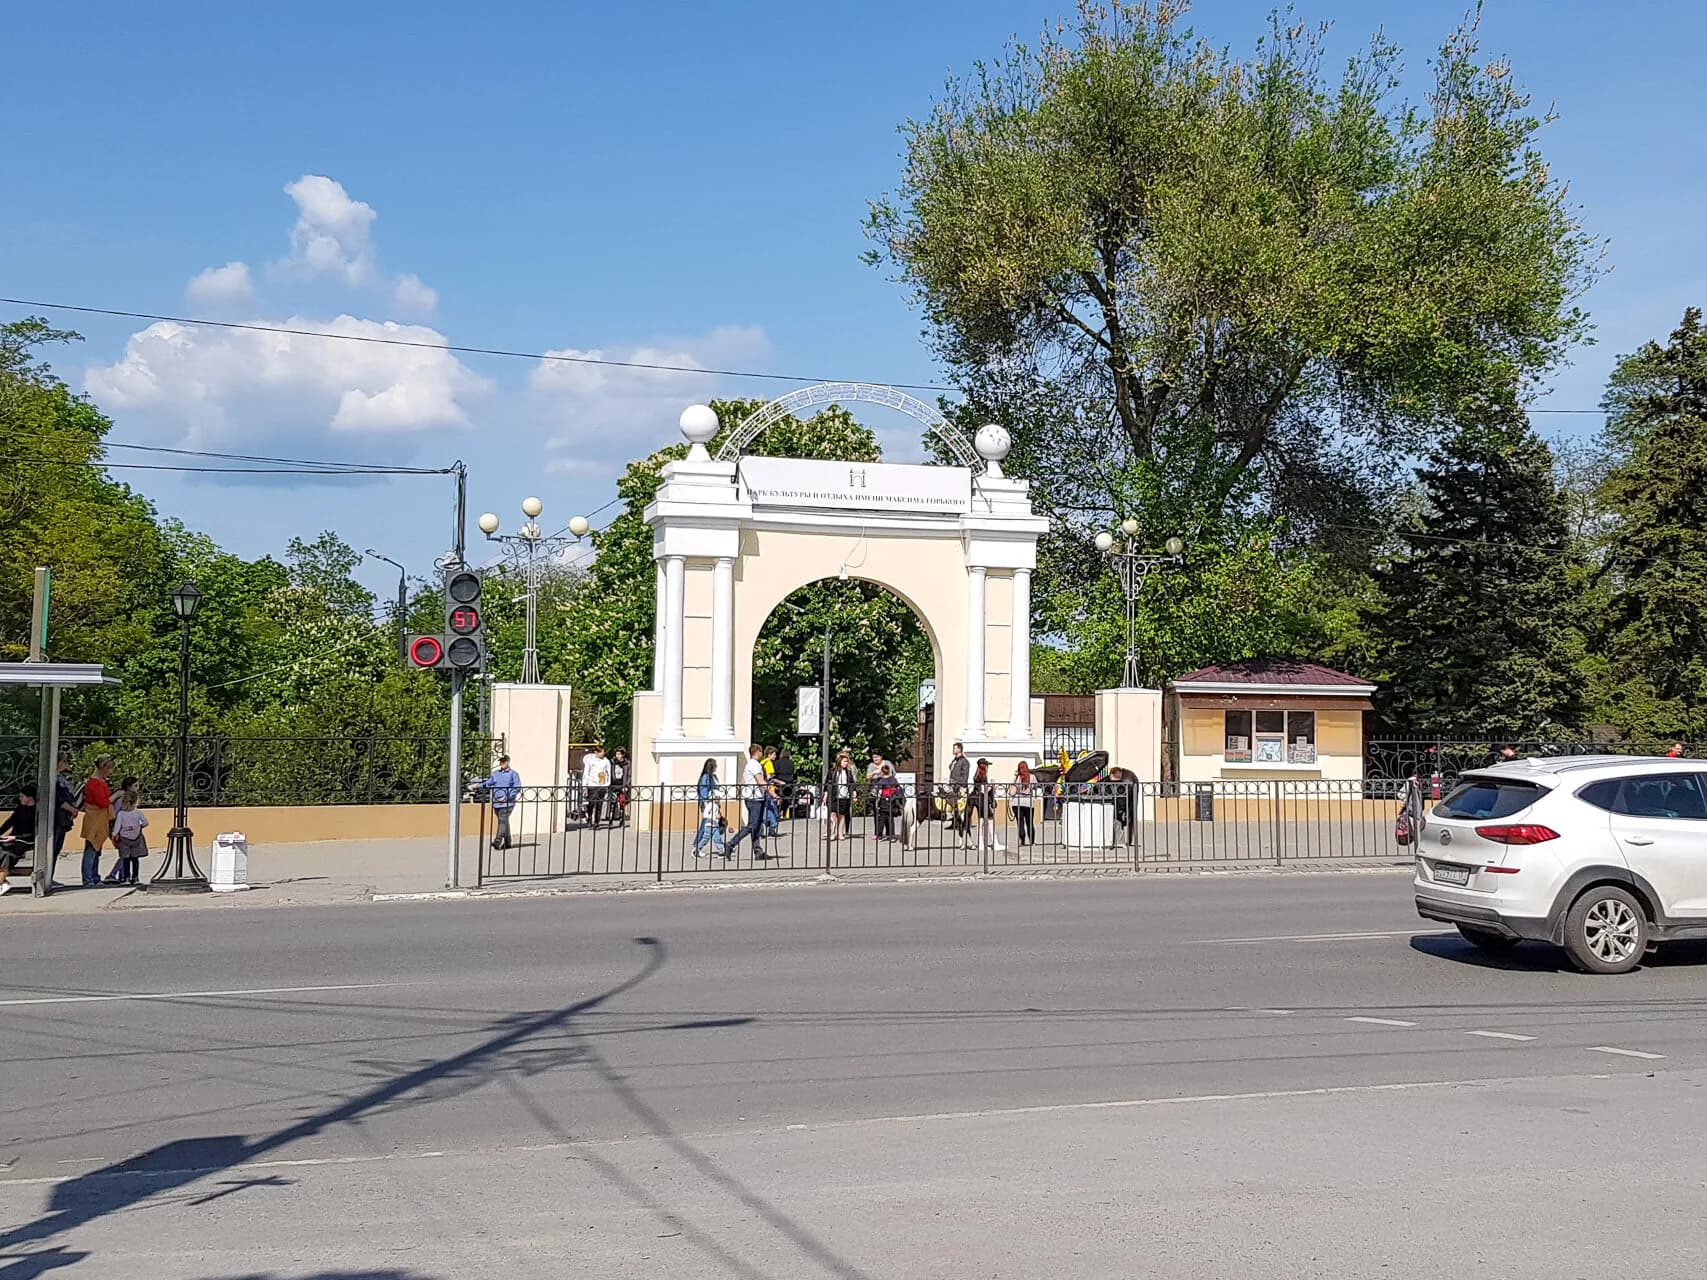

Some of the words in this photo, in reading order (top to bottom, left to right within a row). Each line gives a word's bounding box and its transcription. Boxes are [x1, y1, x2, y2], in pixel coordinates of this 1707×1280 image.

[769, 490, 811, 499] КУЛЬТУРЫ
[820, 492, 853, 501] ОТДЫХА
[885, 496, 924, 504] МАКСИМА
[926, 497, 966, 505] ГОРЬКОГО
[455, 611, 477, 628] 57
